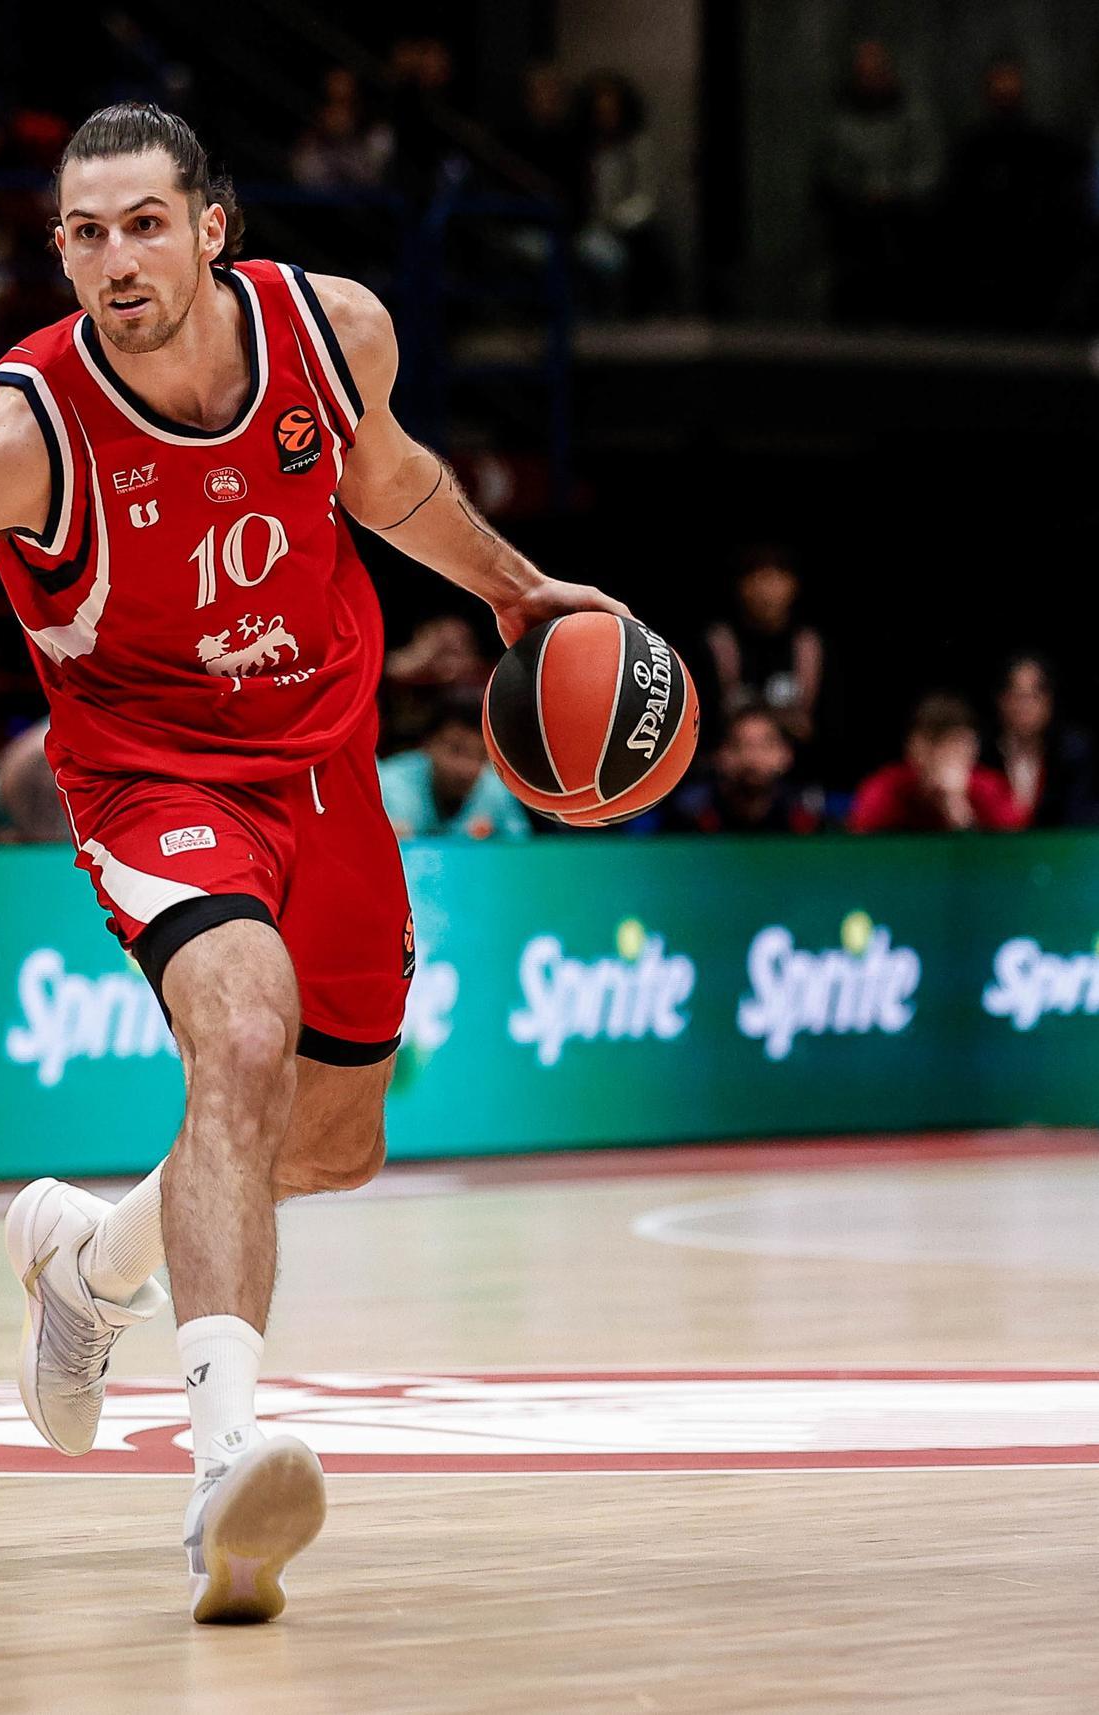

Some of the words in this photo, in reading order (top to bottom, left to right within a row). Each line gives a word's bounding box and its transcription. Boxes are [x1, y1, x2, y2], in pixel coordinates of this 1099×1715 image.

[112, 462, 156, 489] EA7
[187, 512, 289, 610] 10
[626, 625, 672, 760] SPALDING
[164, 828, 207, 846] EA7
[508, 917, 696, 1067] Sprite
[736, 910, 922, 1062] Sprite
